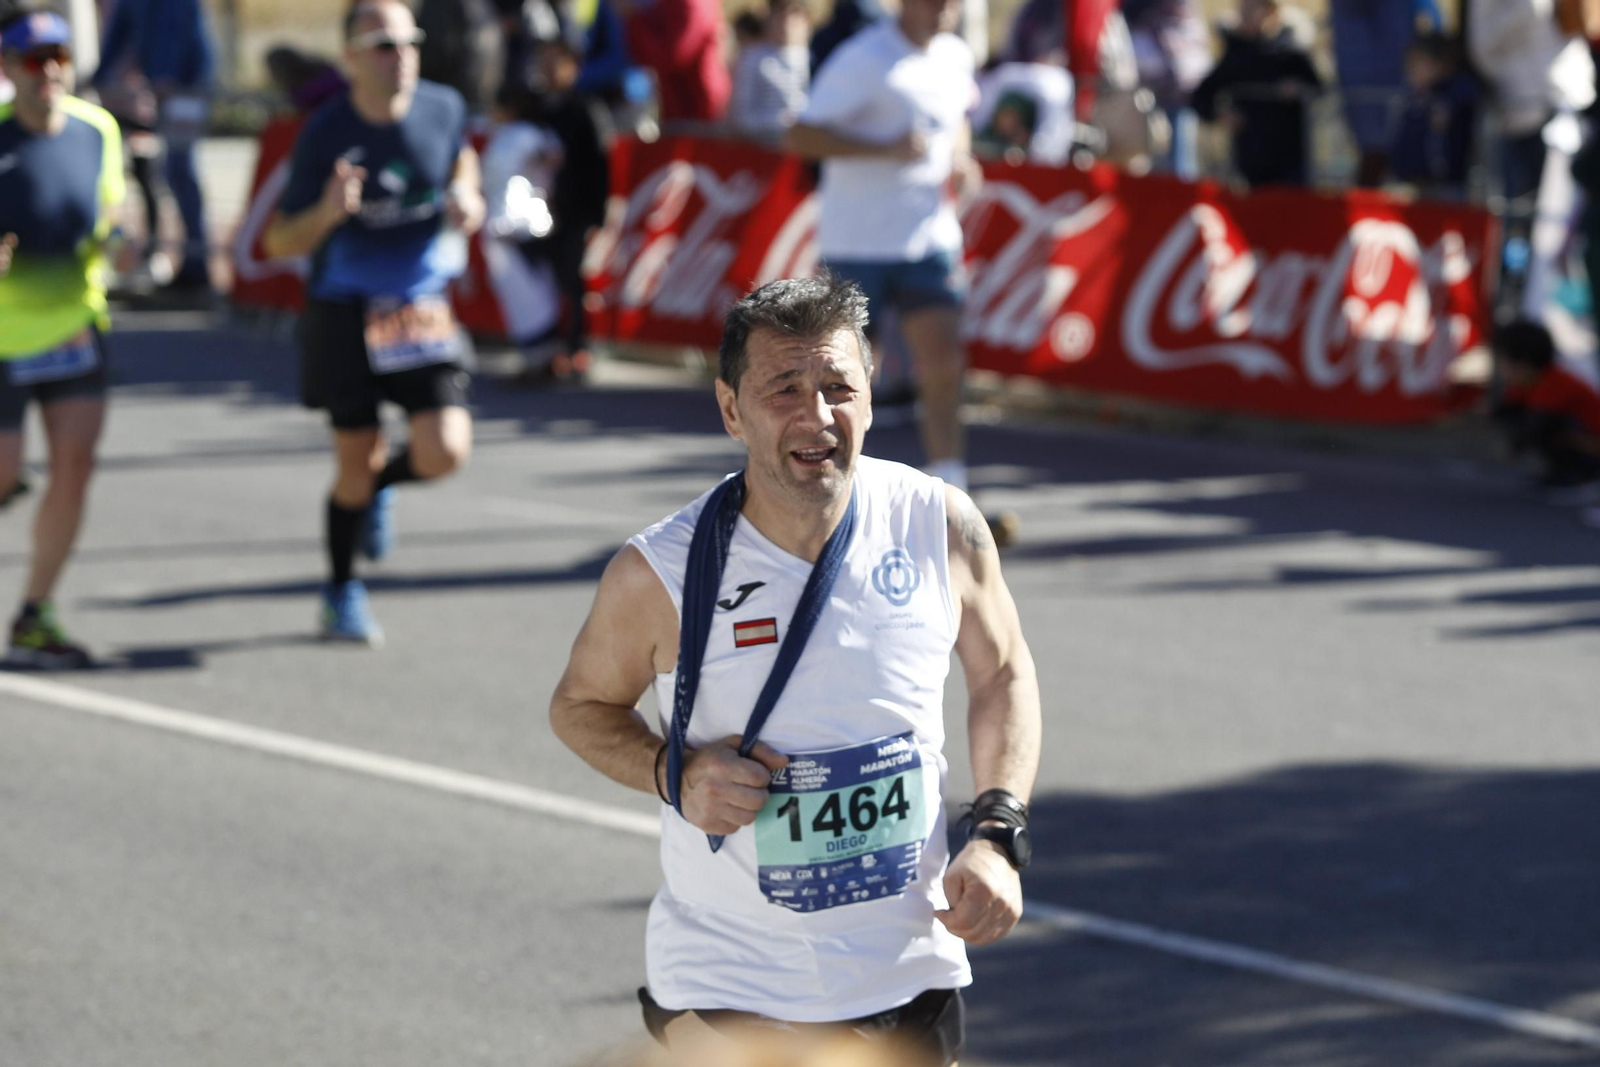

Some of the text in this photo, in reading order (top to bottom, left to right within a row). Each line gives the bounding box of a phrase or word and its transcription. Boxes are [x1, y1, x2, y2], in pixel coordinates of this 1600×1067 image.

[790, 766, 831, 776] MARATÓN
[860, 752, 913, 775] MARATÓN
[777, 776, 910, 842] 1464
[826, 834, 868, 852] DIEGO
